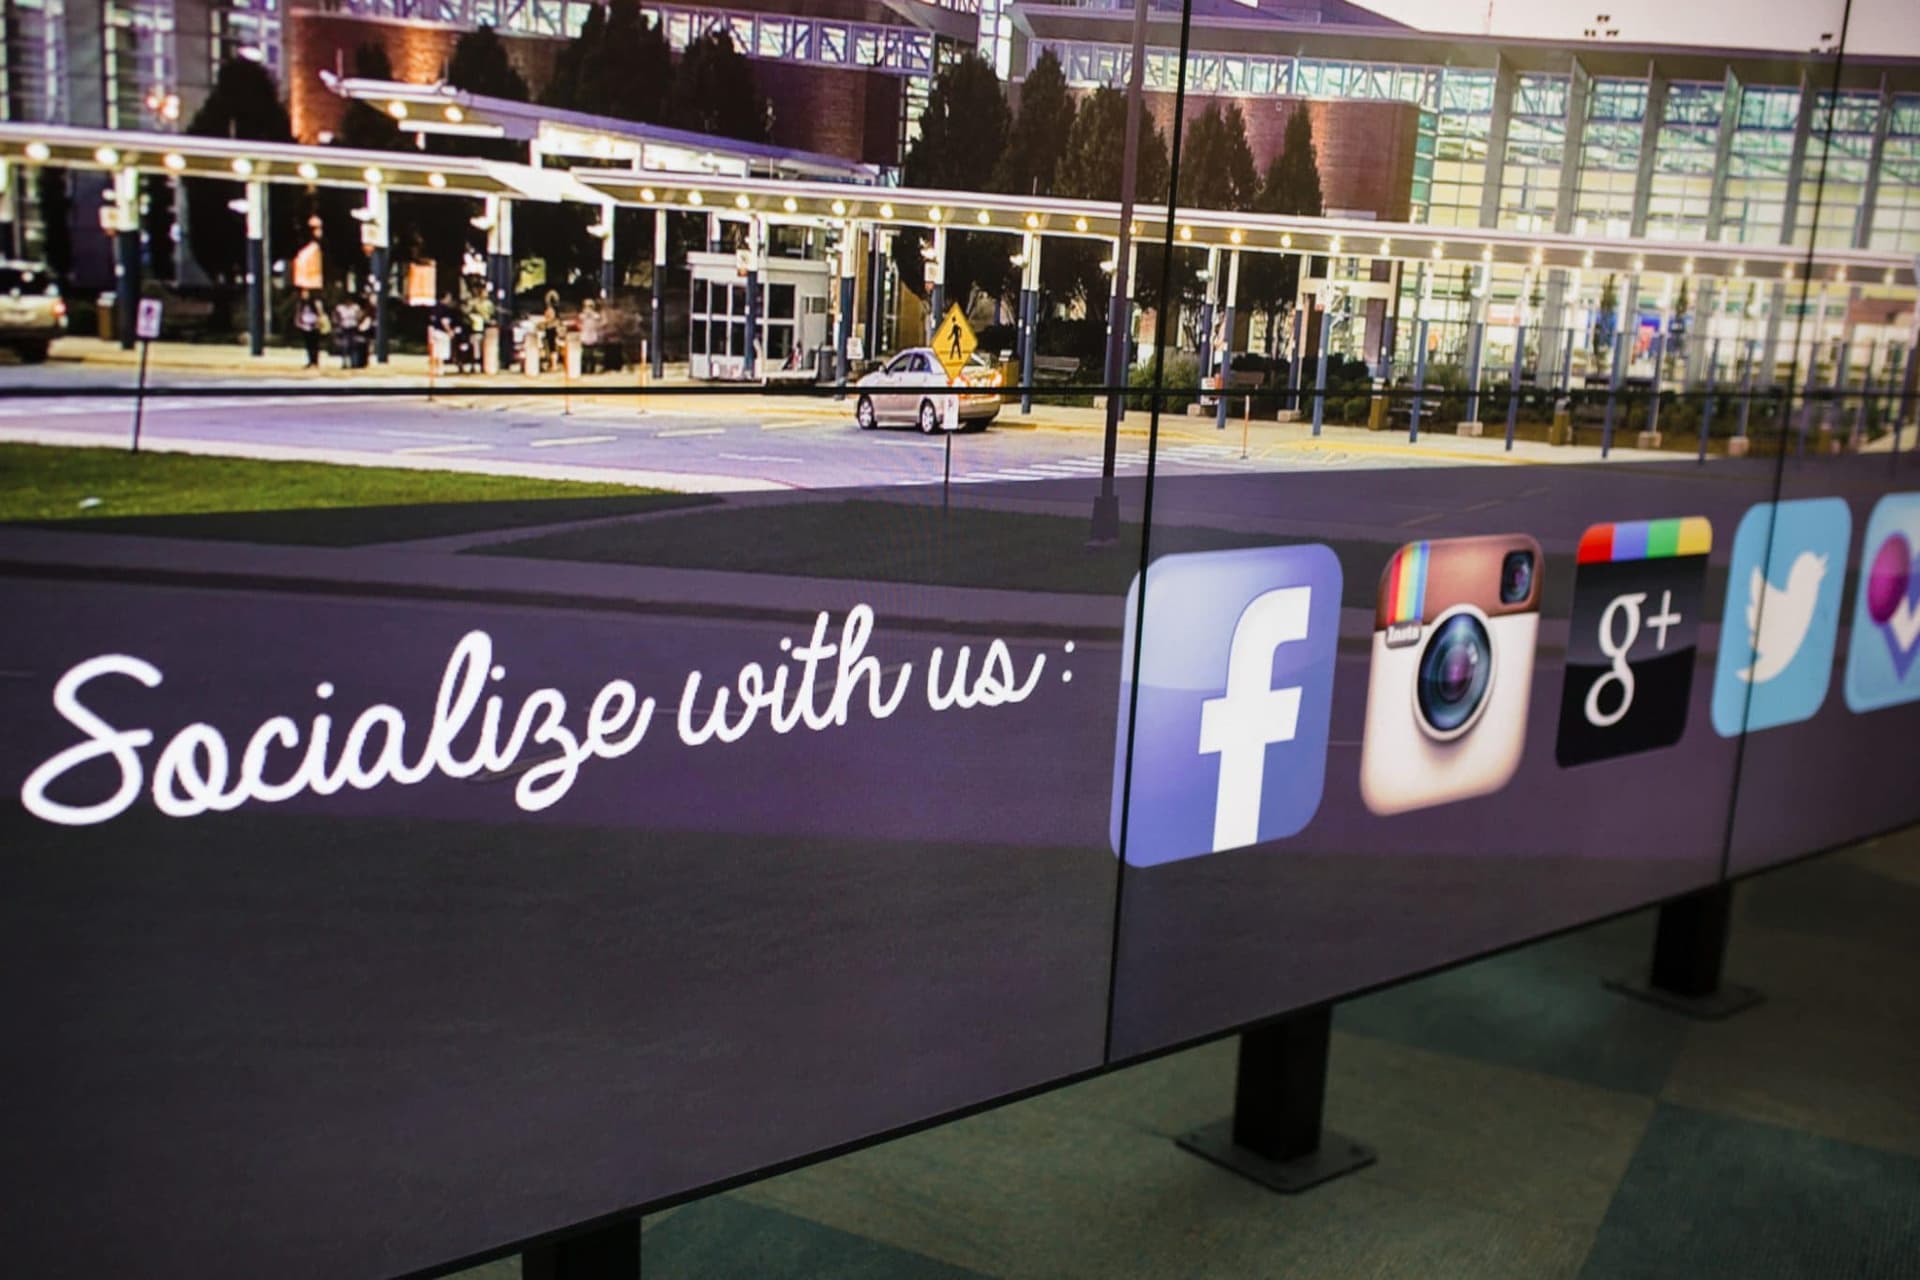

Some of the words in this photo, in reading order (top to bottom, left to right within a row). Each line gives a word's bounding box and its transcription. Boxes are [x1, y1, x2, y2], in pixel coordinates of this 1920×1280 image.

[20, 630, 657, 825] Socialize
[676, 602, 914, 747] with
[1198, 585, 1313, 854] f
[1584, 589, 1683, 727] g+
